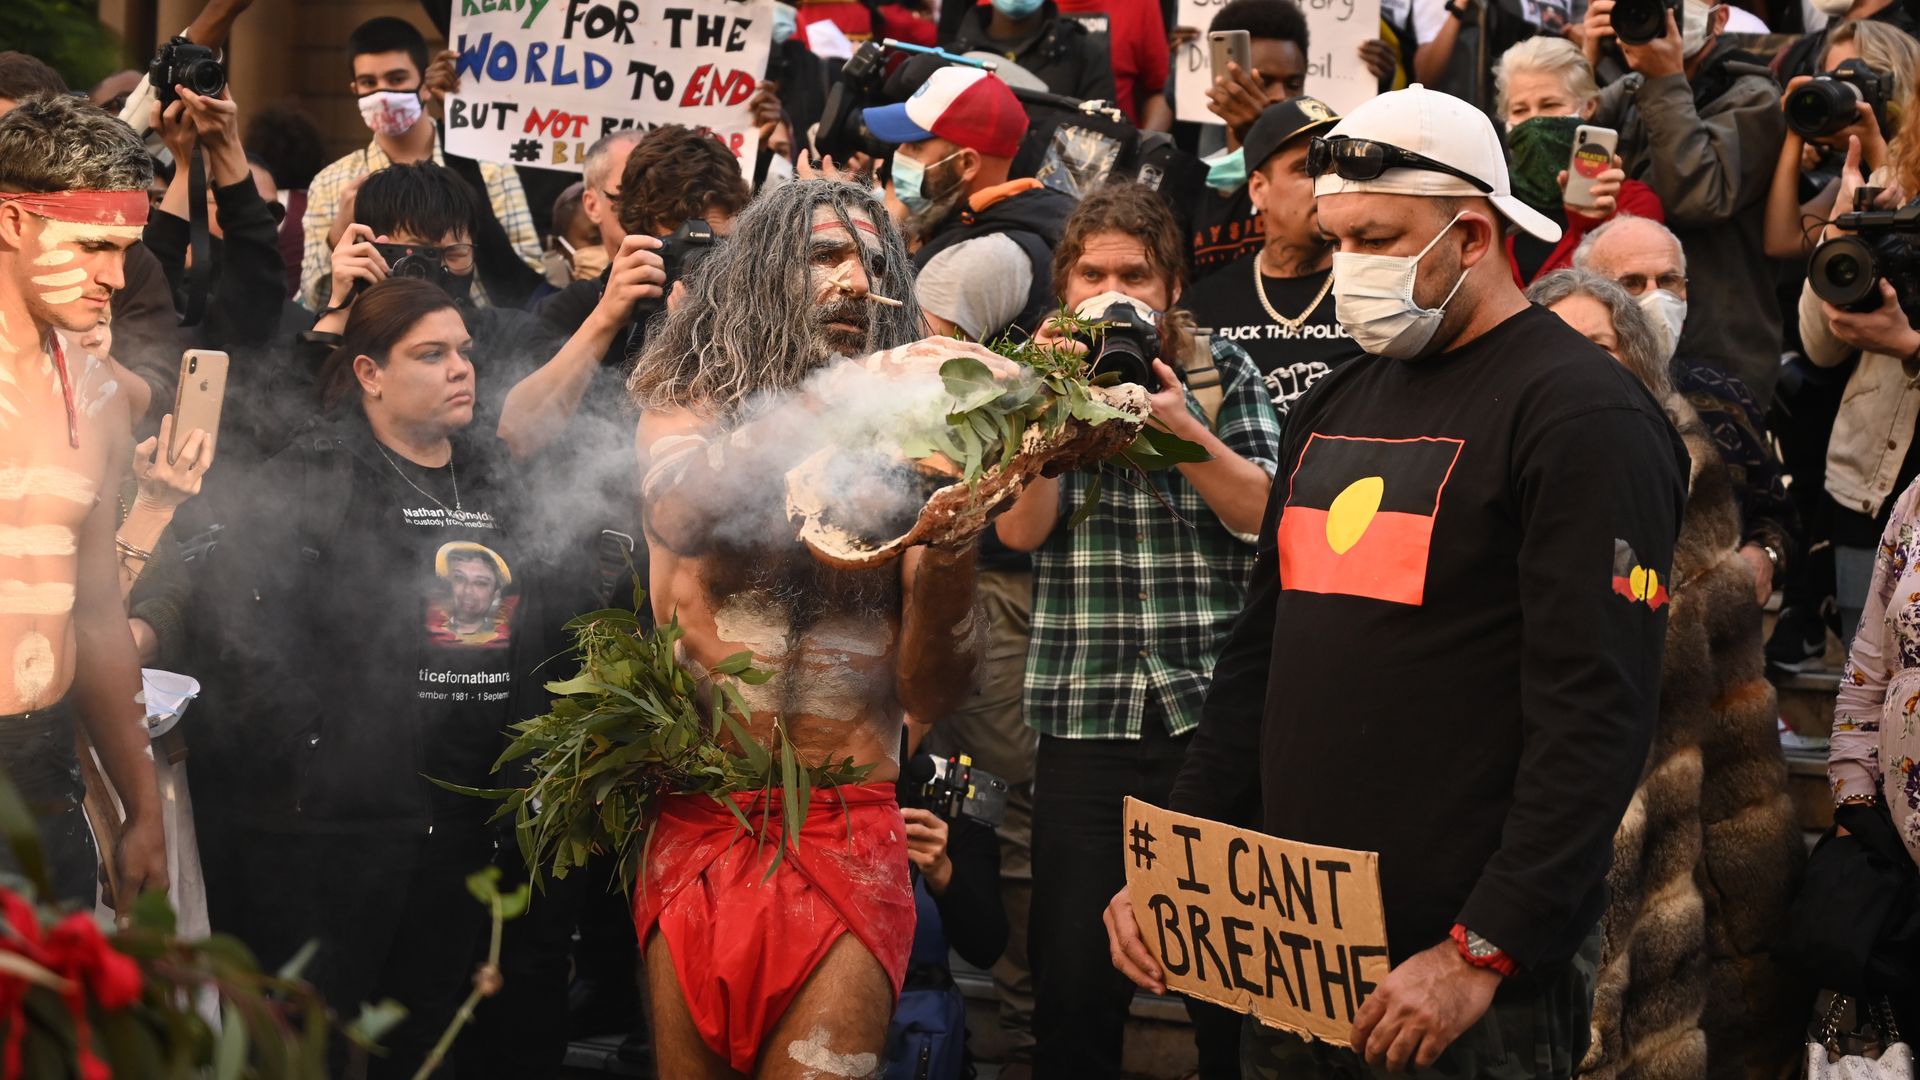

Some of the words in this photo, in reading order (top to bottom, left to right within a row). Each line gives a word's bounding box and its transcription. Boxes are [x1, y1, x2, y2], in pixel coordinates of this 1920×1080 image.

[563, 0, 639, 45] FOR
[663, 8, 752, 52] THE
[457, 32, 613, 90] WORLD
[627, 60, 674, 101] TO
[679, 63, 756, 108] END
[449, 101, 518, 131] BUT
[523, 107, 589, 139] NOT
[402, 507, 445, 518] Nathan
[413, 518, 445, 528] custody
[417, 690, 448, 700] ember
[1172, 824, 1211, 894] I
[1228, 837, 1351, 929] CANT
[1148, 894, 1388, 1025] BREATHE
